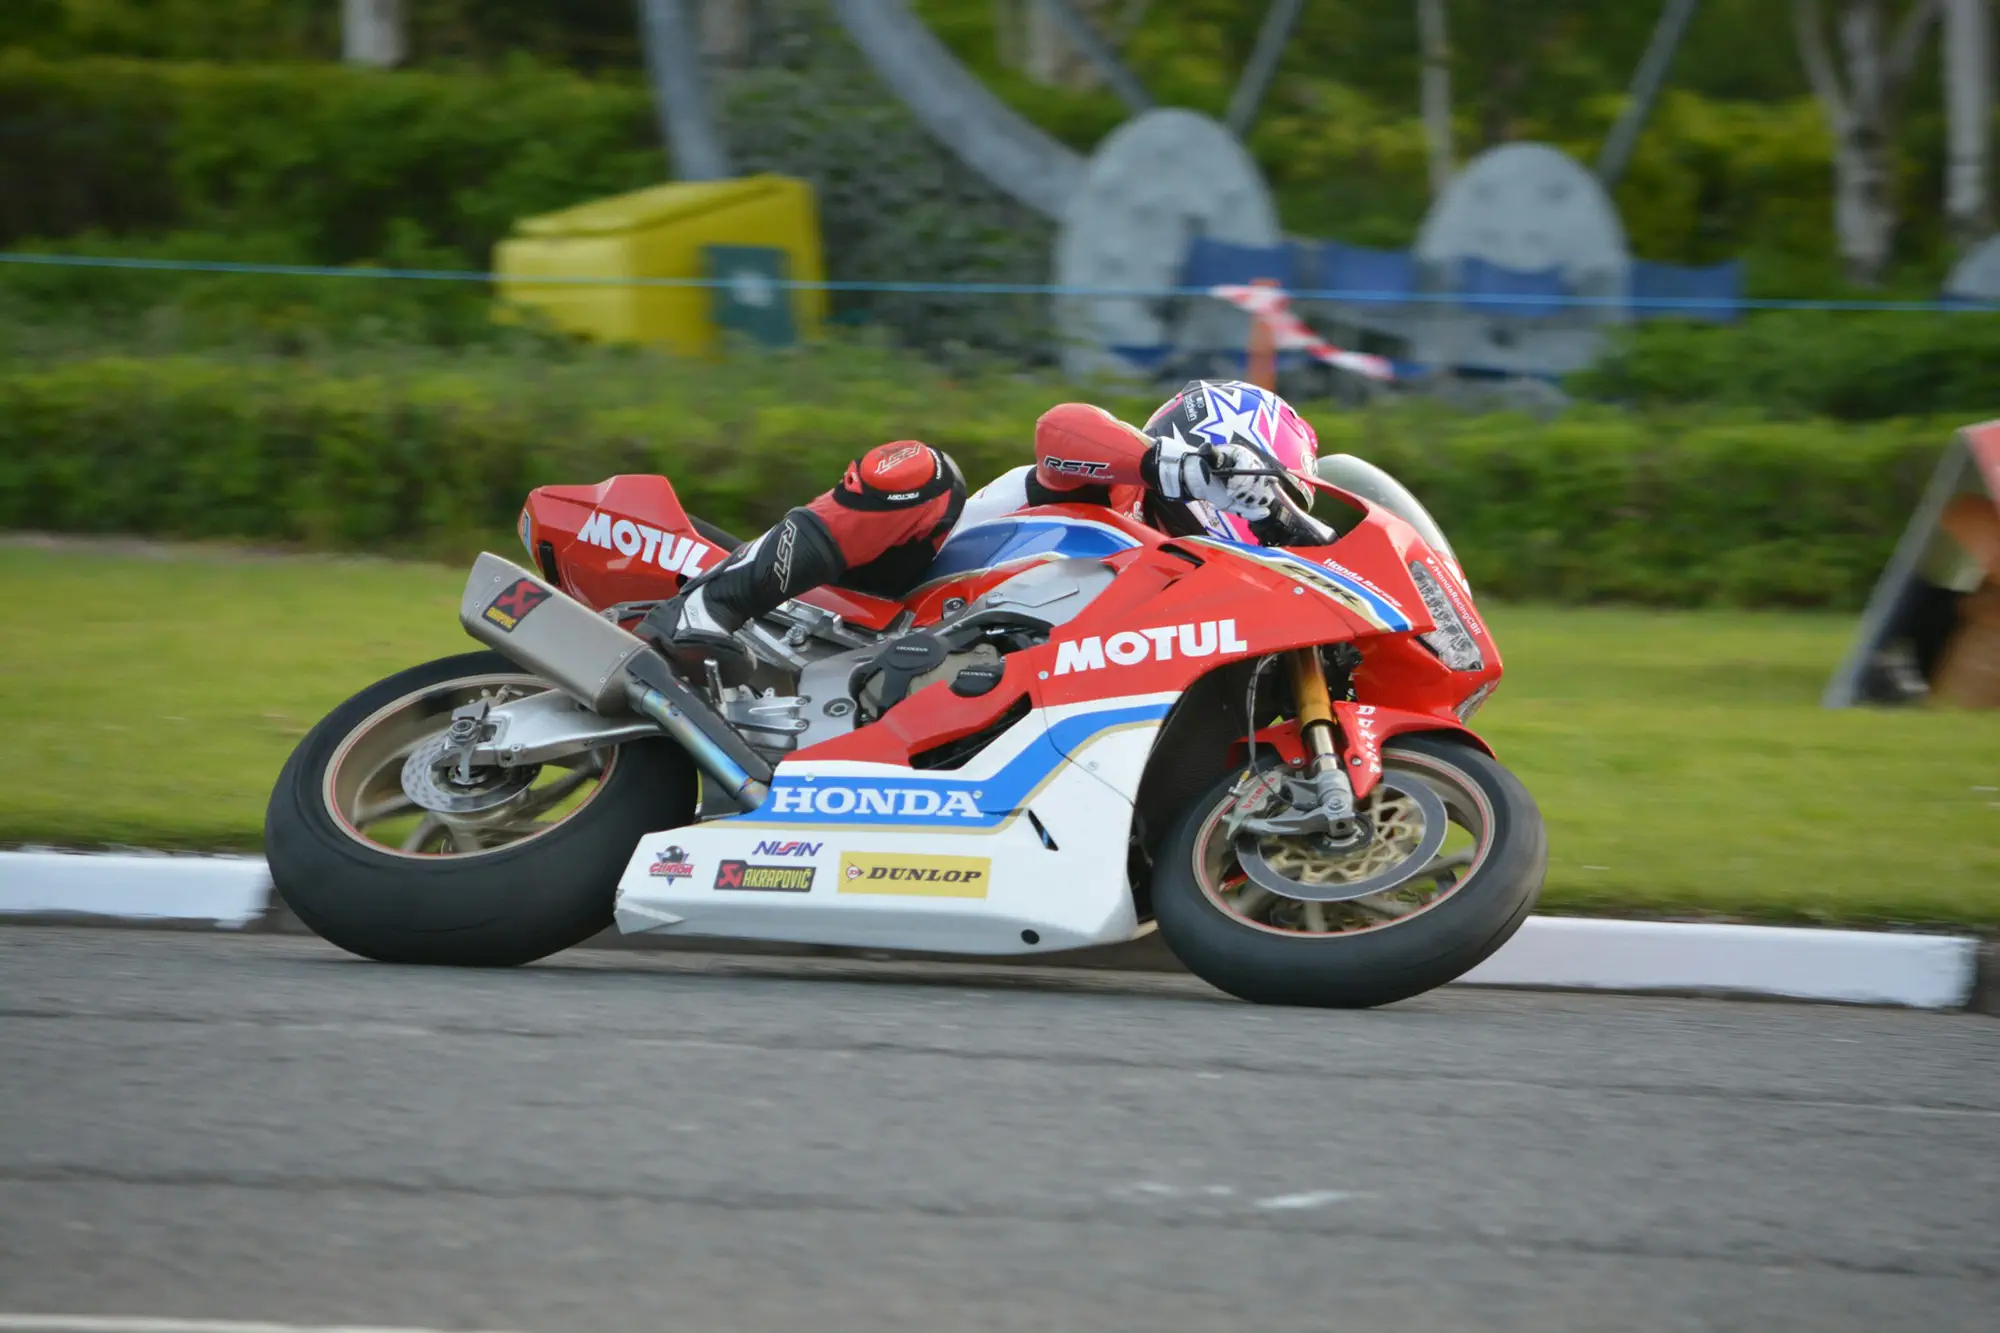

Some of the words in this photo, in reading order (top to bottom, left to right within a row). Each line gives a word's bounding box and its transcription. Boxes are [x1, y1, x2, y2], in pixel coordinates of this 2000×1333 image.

[1043, 455, 1111, 477] RST
[576, 509, 711, 579] MOTUL
[773, 519, 798, 594] RST
[1322, 557, 1365, 582] Honda
[1053, 618, 1248, 677] MOTUL
[771, 786, 984, 818] HONDA
[866, 866, 983, 884] DUNLOP
